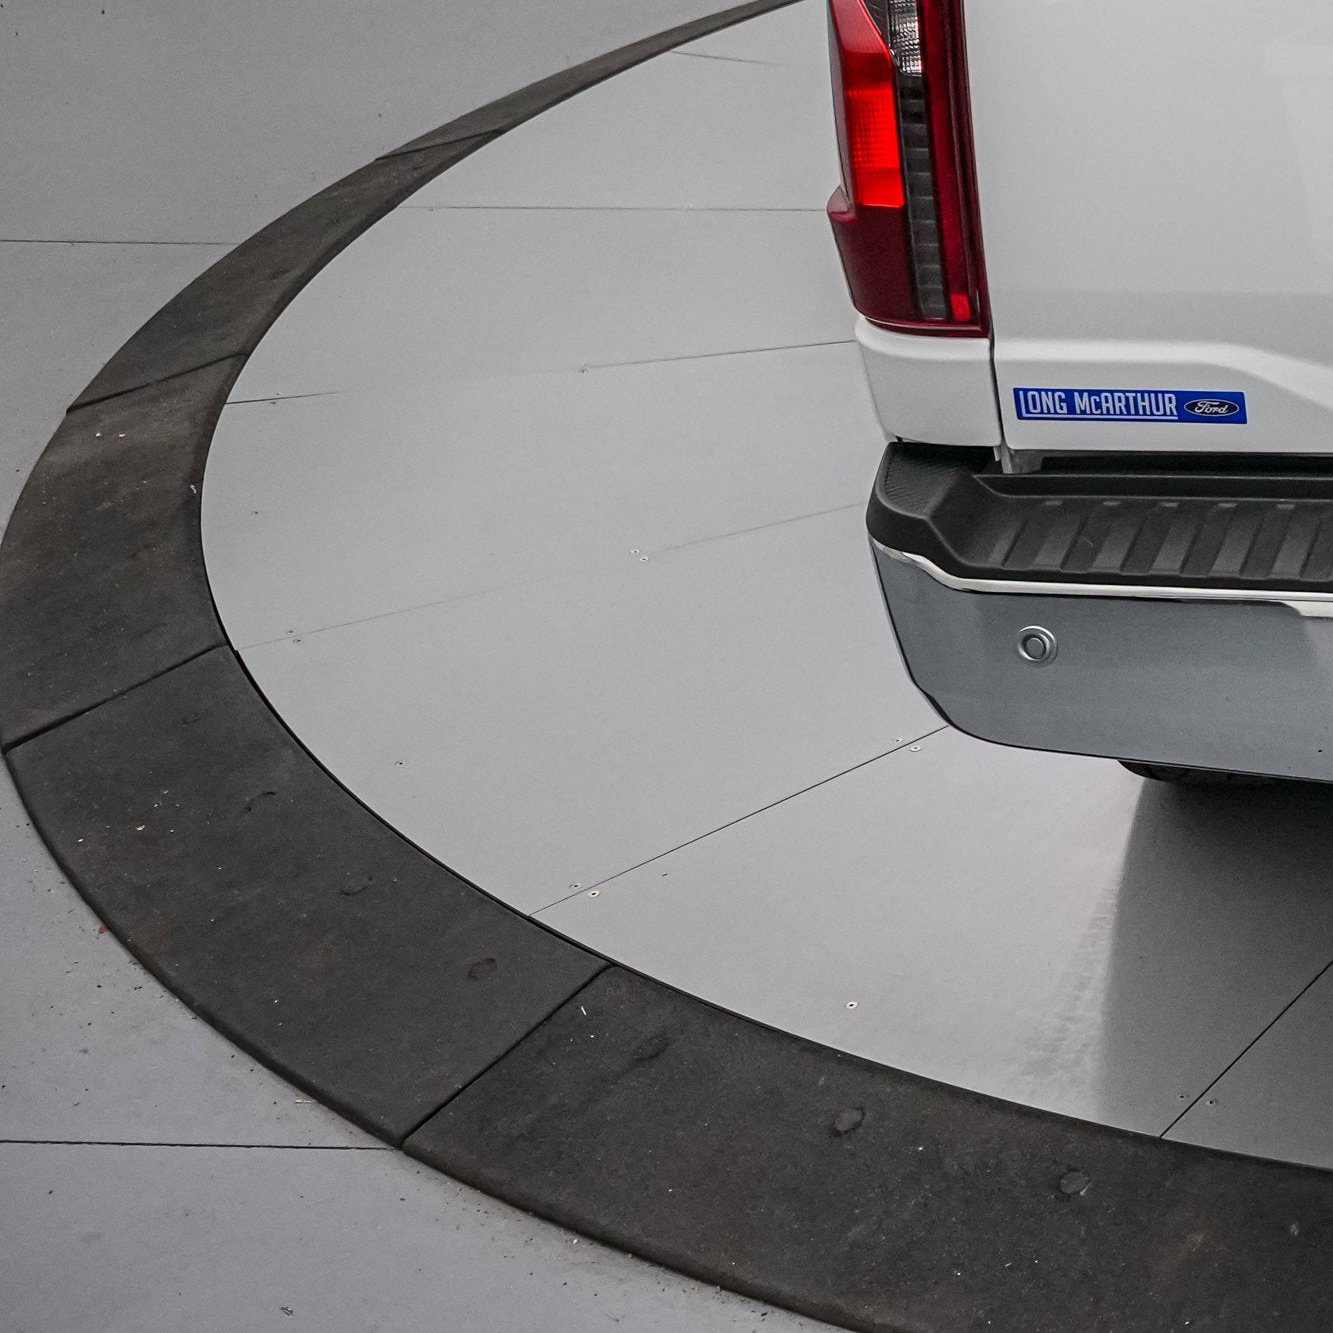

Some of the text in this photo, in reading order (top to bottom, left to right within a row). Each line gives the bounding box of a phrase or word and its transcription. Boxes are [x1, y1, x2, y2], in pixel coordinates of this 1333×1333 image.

[1018, 390, 1177, 417] LONG McARTHUR
[1193, 400, 1229, 415] Ford
